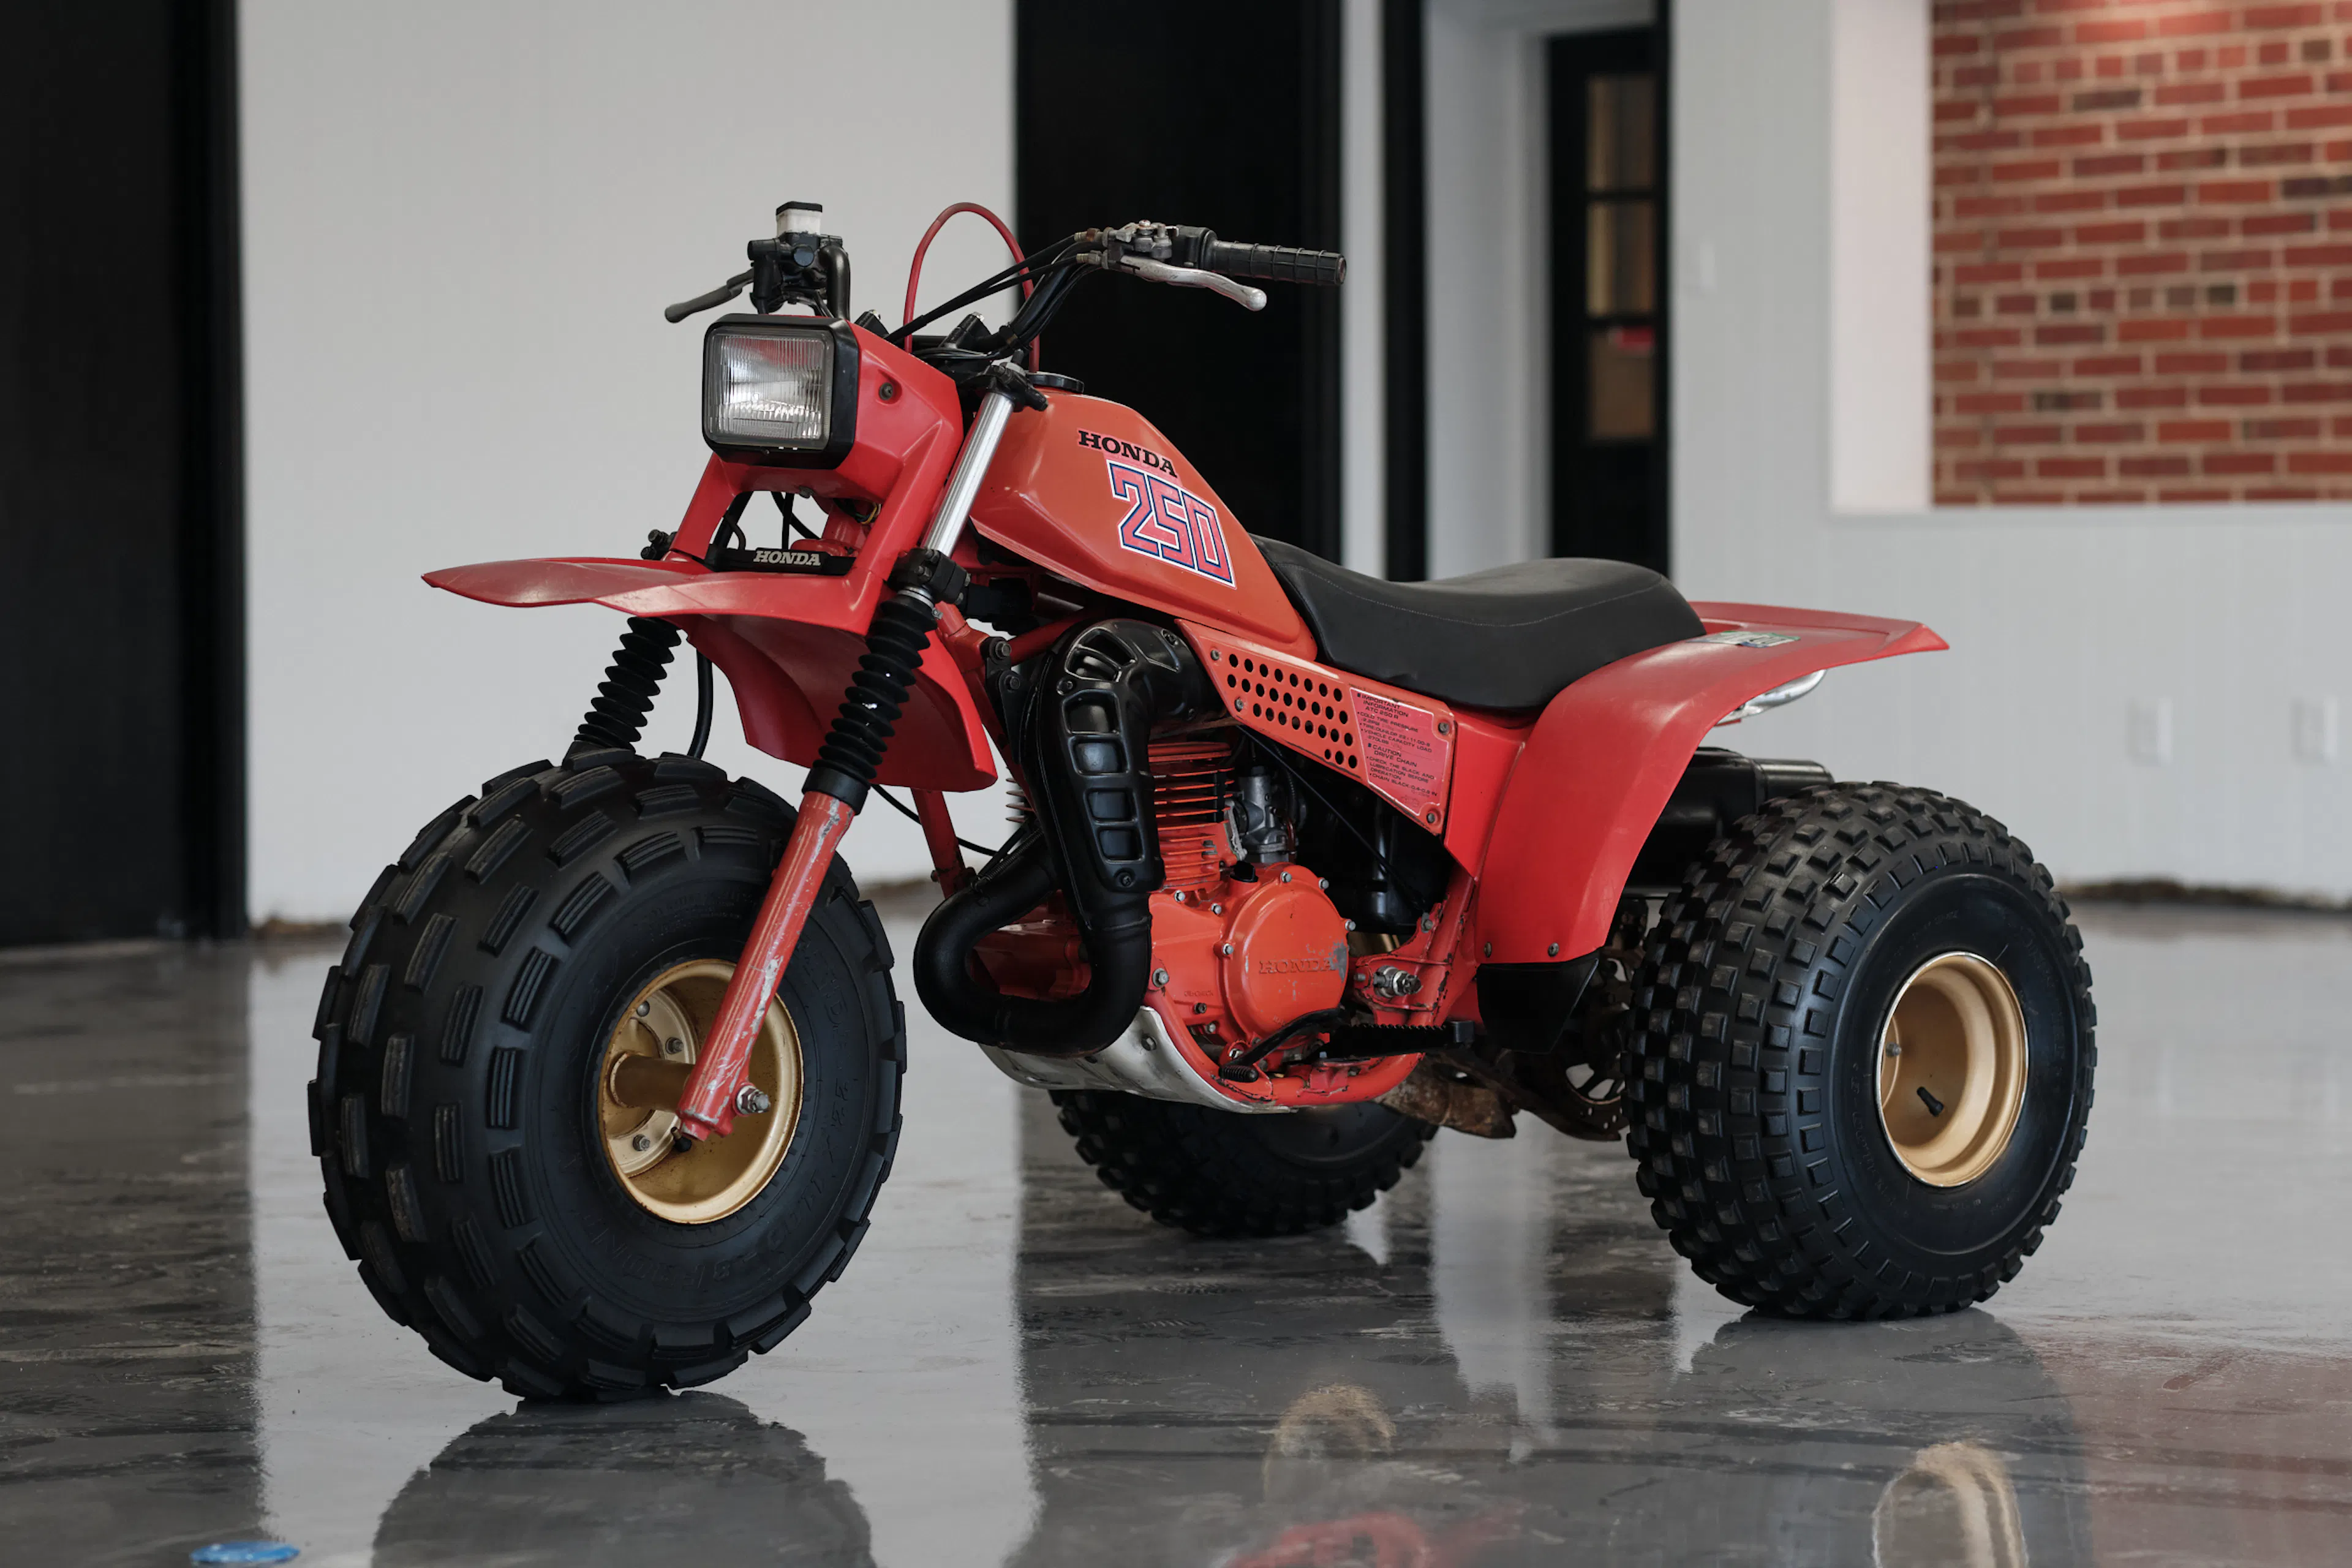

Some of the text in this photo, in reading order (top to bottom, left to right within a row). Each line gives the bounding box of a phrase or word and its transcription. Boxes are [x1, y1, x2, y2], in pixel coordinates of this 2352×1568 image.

[1079, 430, 1177, 478] HONDA
[1106, 459, 1236, 589] 250
[753, 551, 821, 566] HONDA
[1362, 695, 1400, 709] IMPORTANT
[1363, 700, 1408, 717] INFORMATION
[1390, 721, 1418, 733] PRESSURE
[1364, 729, 1385, 739] VEHICLE
[1388, 736, 1414, 747] CAPACITY
[1373, 745, 1401, 757] CAUTION
[1374, 750, 1417, 767] DRIVE CHAIN
[1370, 763, 1428, 783] LUBRICATION BEFORE
[1371, 767, 1401, 780] OPERATION
[1259, 959, 1336, 974] HONDA
